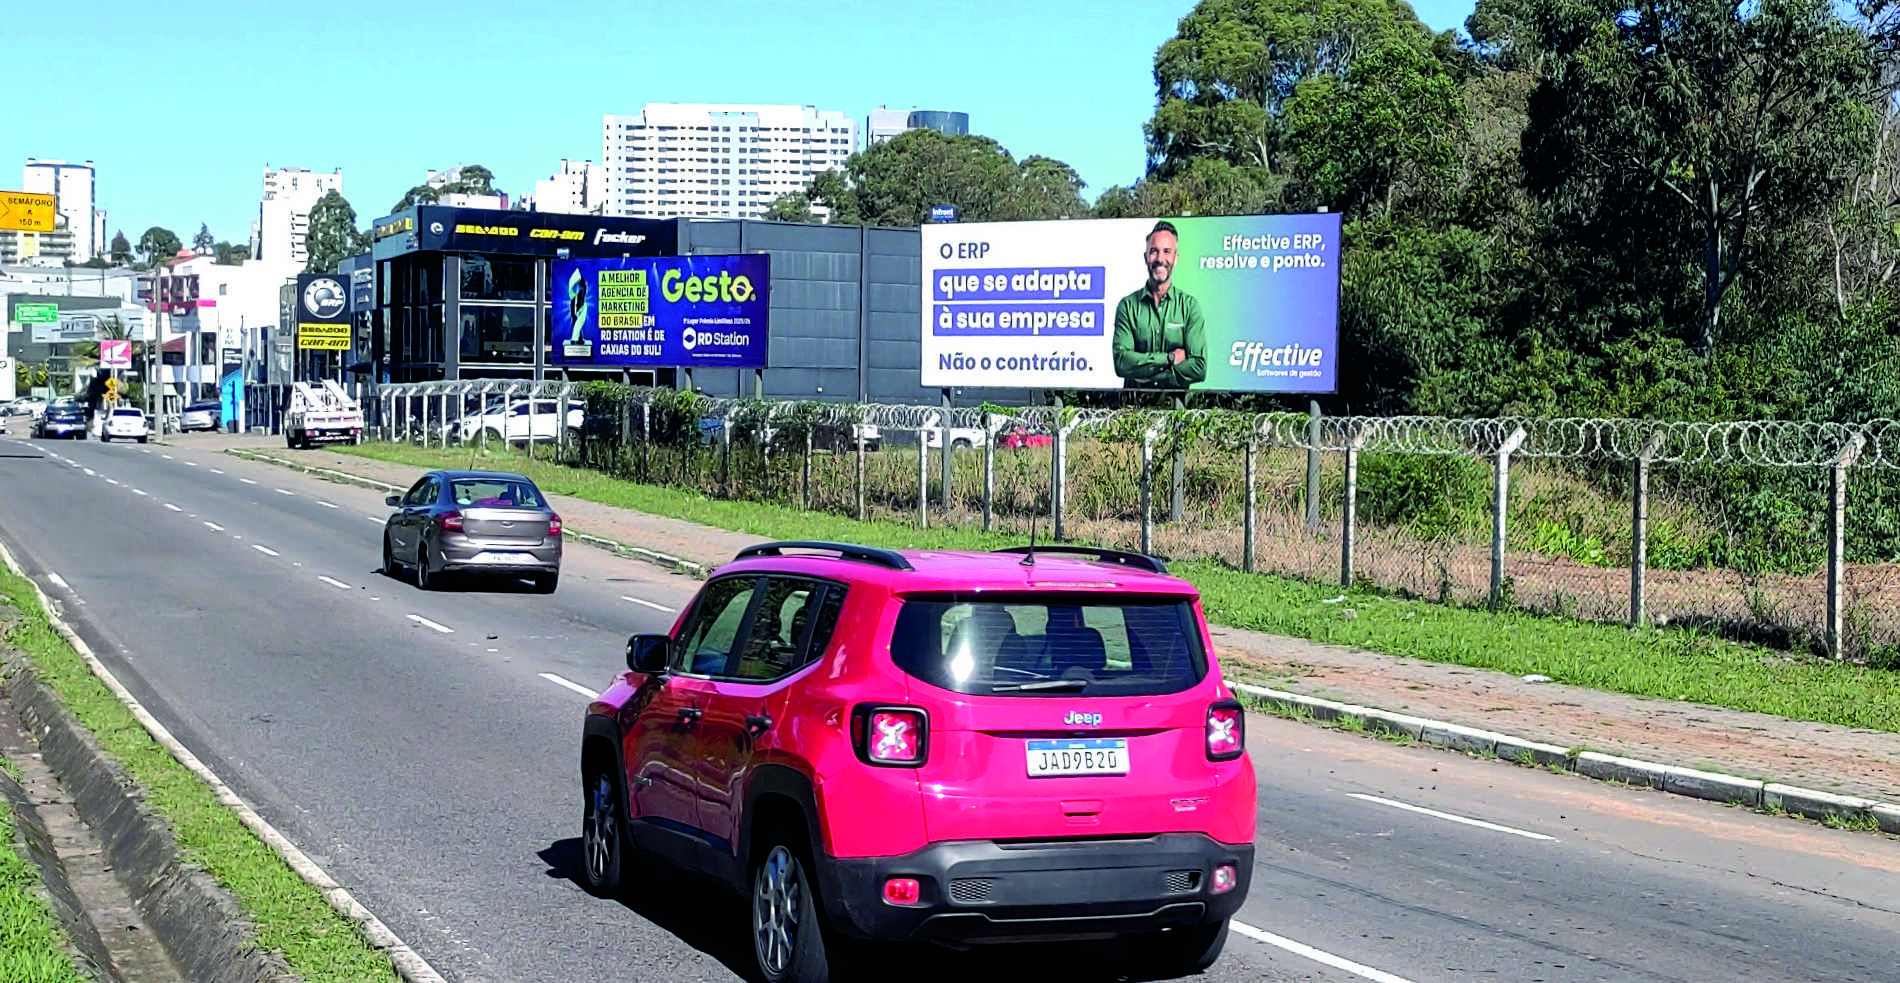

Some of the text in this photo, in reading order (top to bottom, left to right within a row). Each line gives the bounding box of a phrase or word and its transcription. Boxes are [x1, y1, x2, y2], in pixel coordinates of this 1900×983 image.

[939, 241, 990, 259] O ERP
[1223, 233, 1326, 251] Effective ERP,
[1199, 252, 1326, 273] resolve e ponto.
[601, 272, 641, 283] A MELHOR
[939, 268, 1092, 300] que se adapta
[636, 287, 647, 298] DE
[601, 302, 646, 312] MARKETING
[601, 315, 655, 327] DO BRASIL EM
[939, 305, 1095, 336] à sua empresa
[600, 329, 612, 342] RD
[613, 329, 646, 342] STATION
[654, 329, 665, 342] DE
[697, 331, 750, 346] RD Station
[600, 343, 630, 356] CAXIAS
[631, 344, 642, 356] DO
[1229, 341, 1323, 373] Effective
[939, 351, 1094, 372] Não o contrário.
[1063, 710, 1102, 727] Jeep
